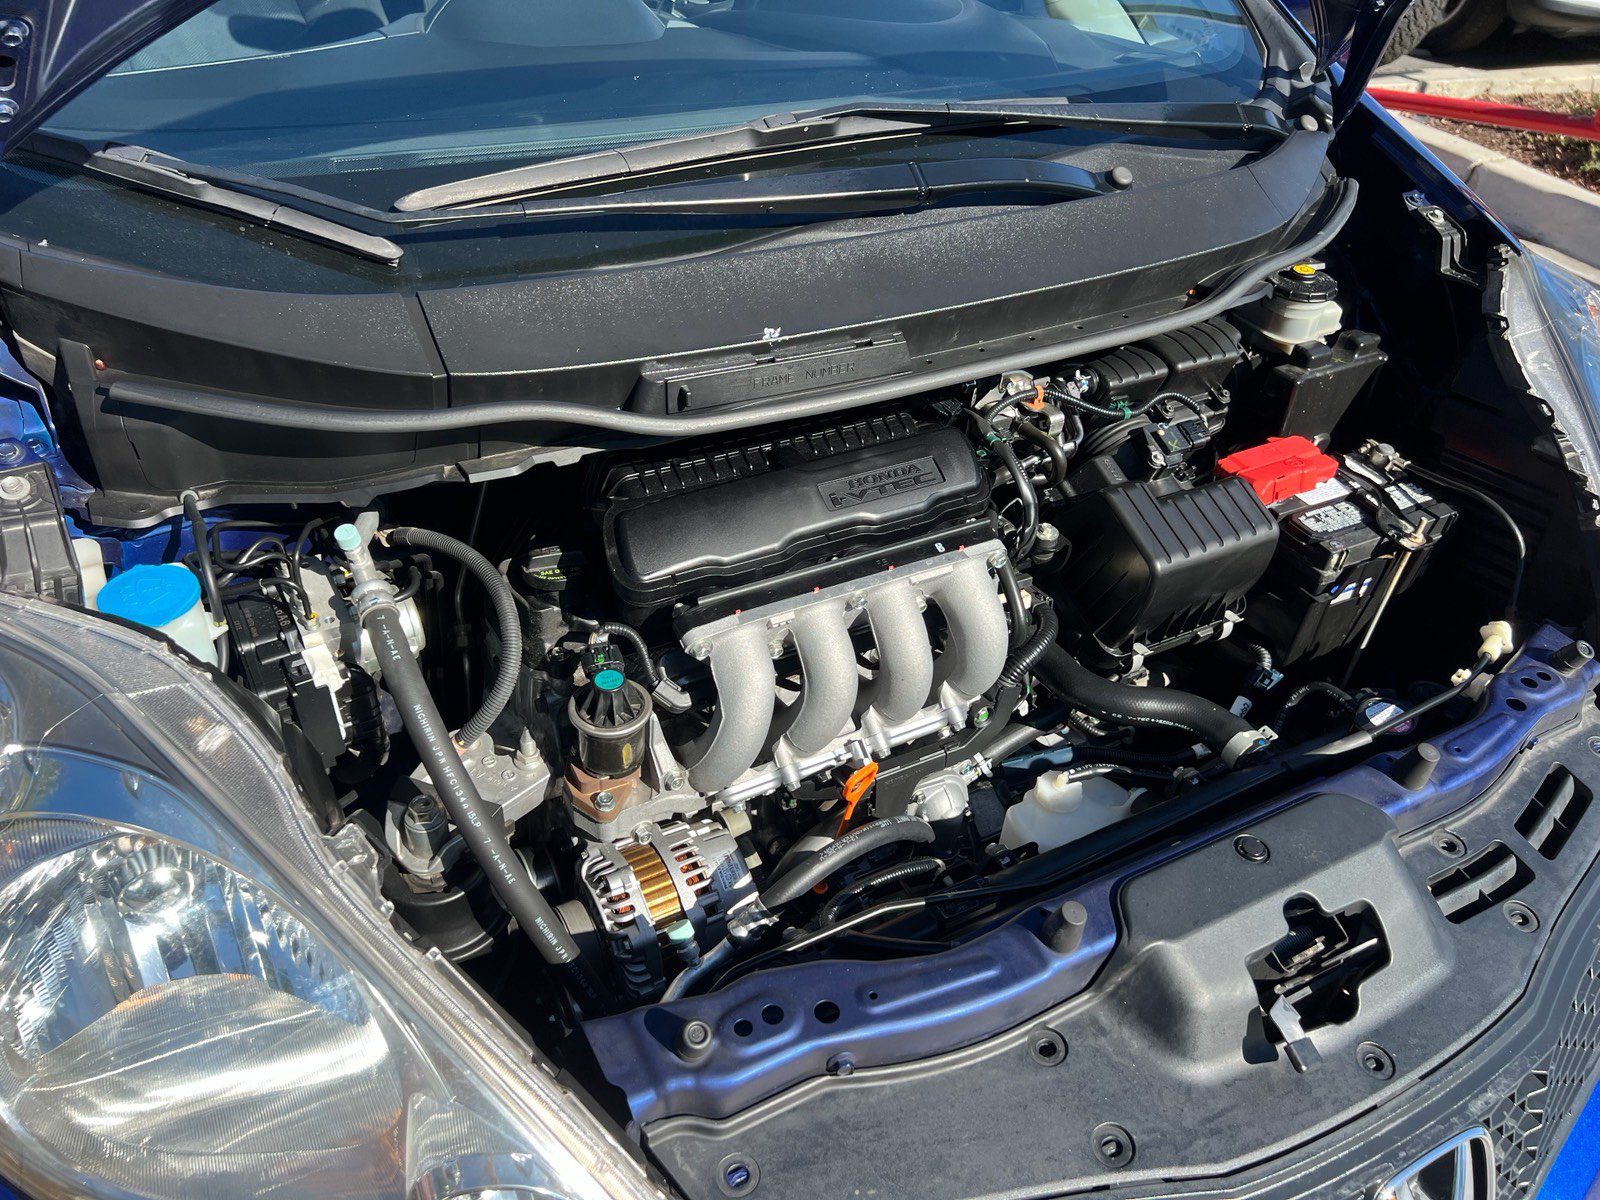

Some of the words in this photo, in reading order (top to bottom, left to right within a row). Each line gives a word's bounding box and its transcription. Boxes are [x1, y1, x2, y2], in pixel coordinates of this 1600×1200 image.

[753, 372, 795, 389] FRAME
[805, 362, 855, 380] NUMBER
[828, 471, 937, 508] i-VTEC
[846, 464, 922, 489] HONDA
[412, 703, 437, 743] NICHIRIN
[432, 746, 446, 764] JPN
[534, 916, 559, 946] NICHIRIN
[555, 945, 569, 960] JPN
